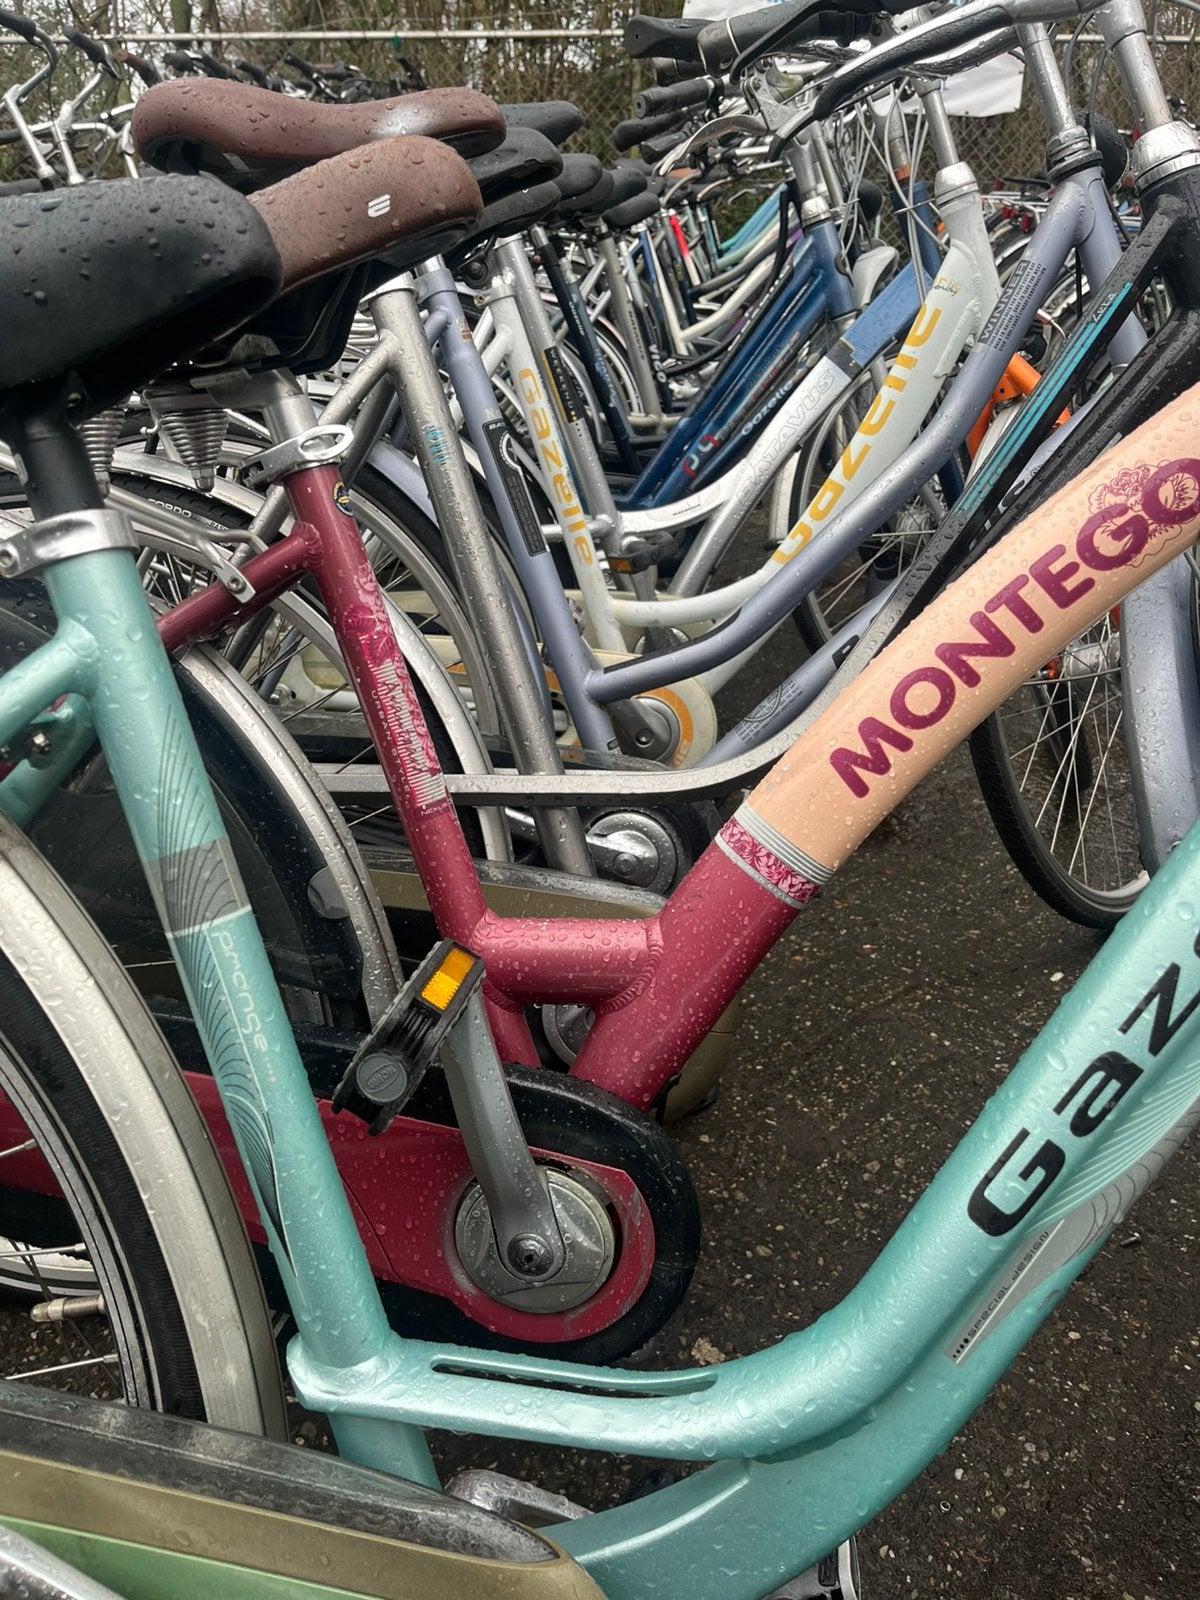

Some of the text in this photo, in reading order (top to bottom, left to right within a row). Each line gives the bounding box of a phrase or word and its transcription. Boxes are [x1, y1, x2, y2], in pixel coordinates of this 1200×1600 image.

[981, 260, 1028, 340] WINNER
[549, 348, 574, 409] WEEKEND
[735, 367, 836, 507] BATAVUS
[740, 379, 795, 436] Gazelle
[771, 302, 943, 566] Gazelle
[517, 366, 595, 567] Gazelle
[828, 457, 1200, 799] MONTEGO
[370, 689, 392, 741] URBAN
[218, 931, 269, 1053] orange
[366, 1064, 397, 1089] UNION
[966, 924, 1200, 1237] Gaz
